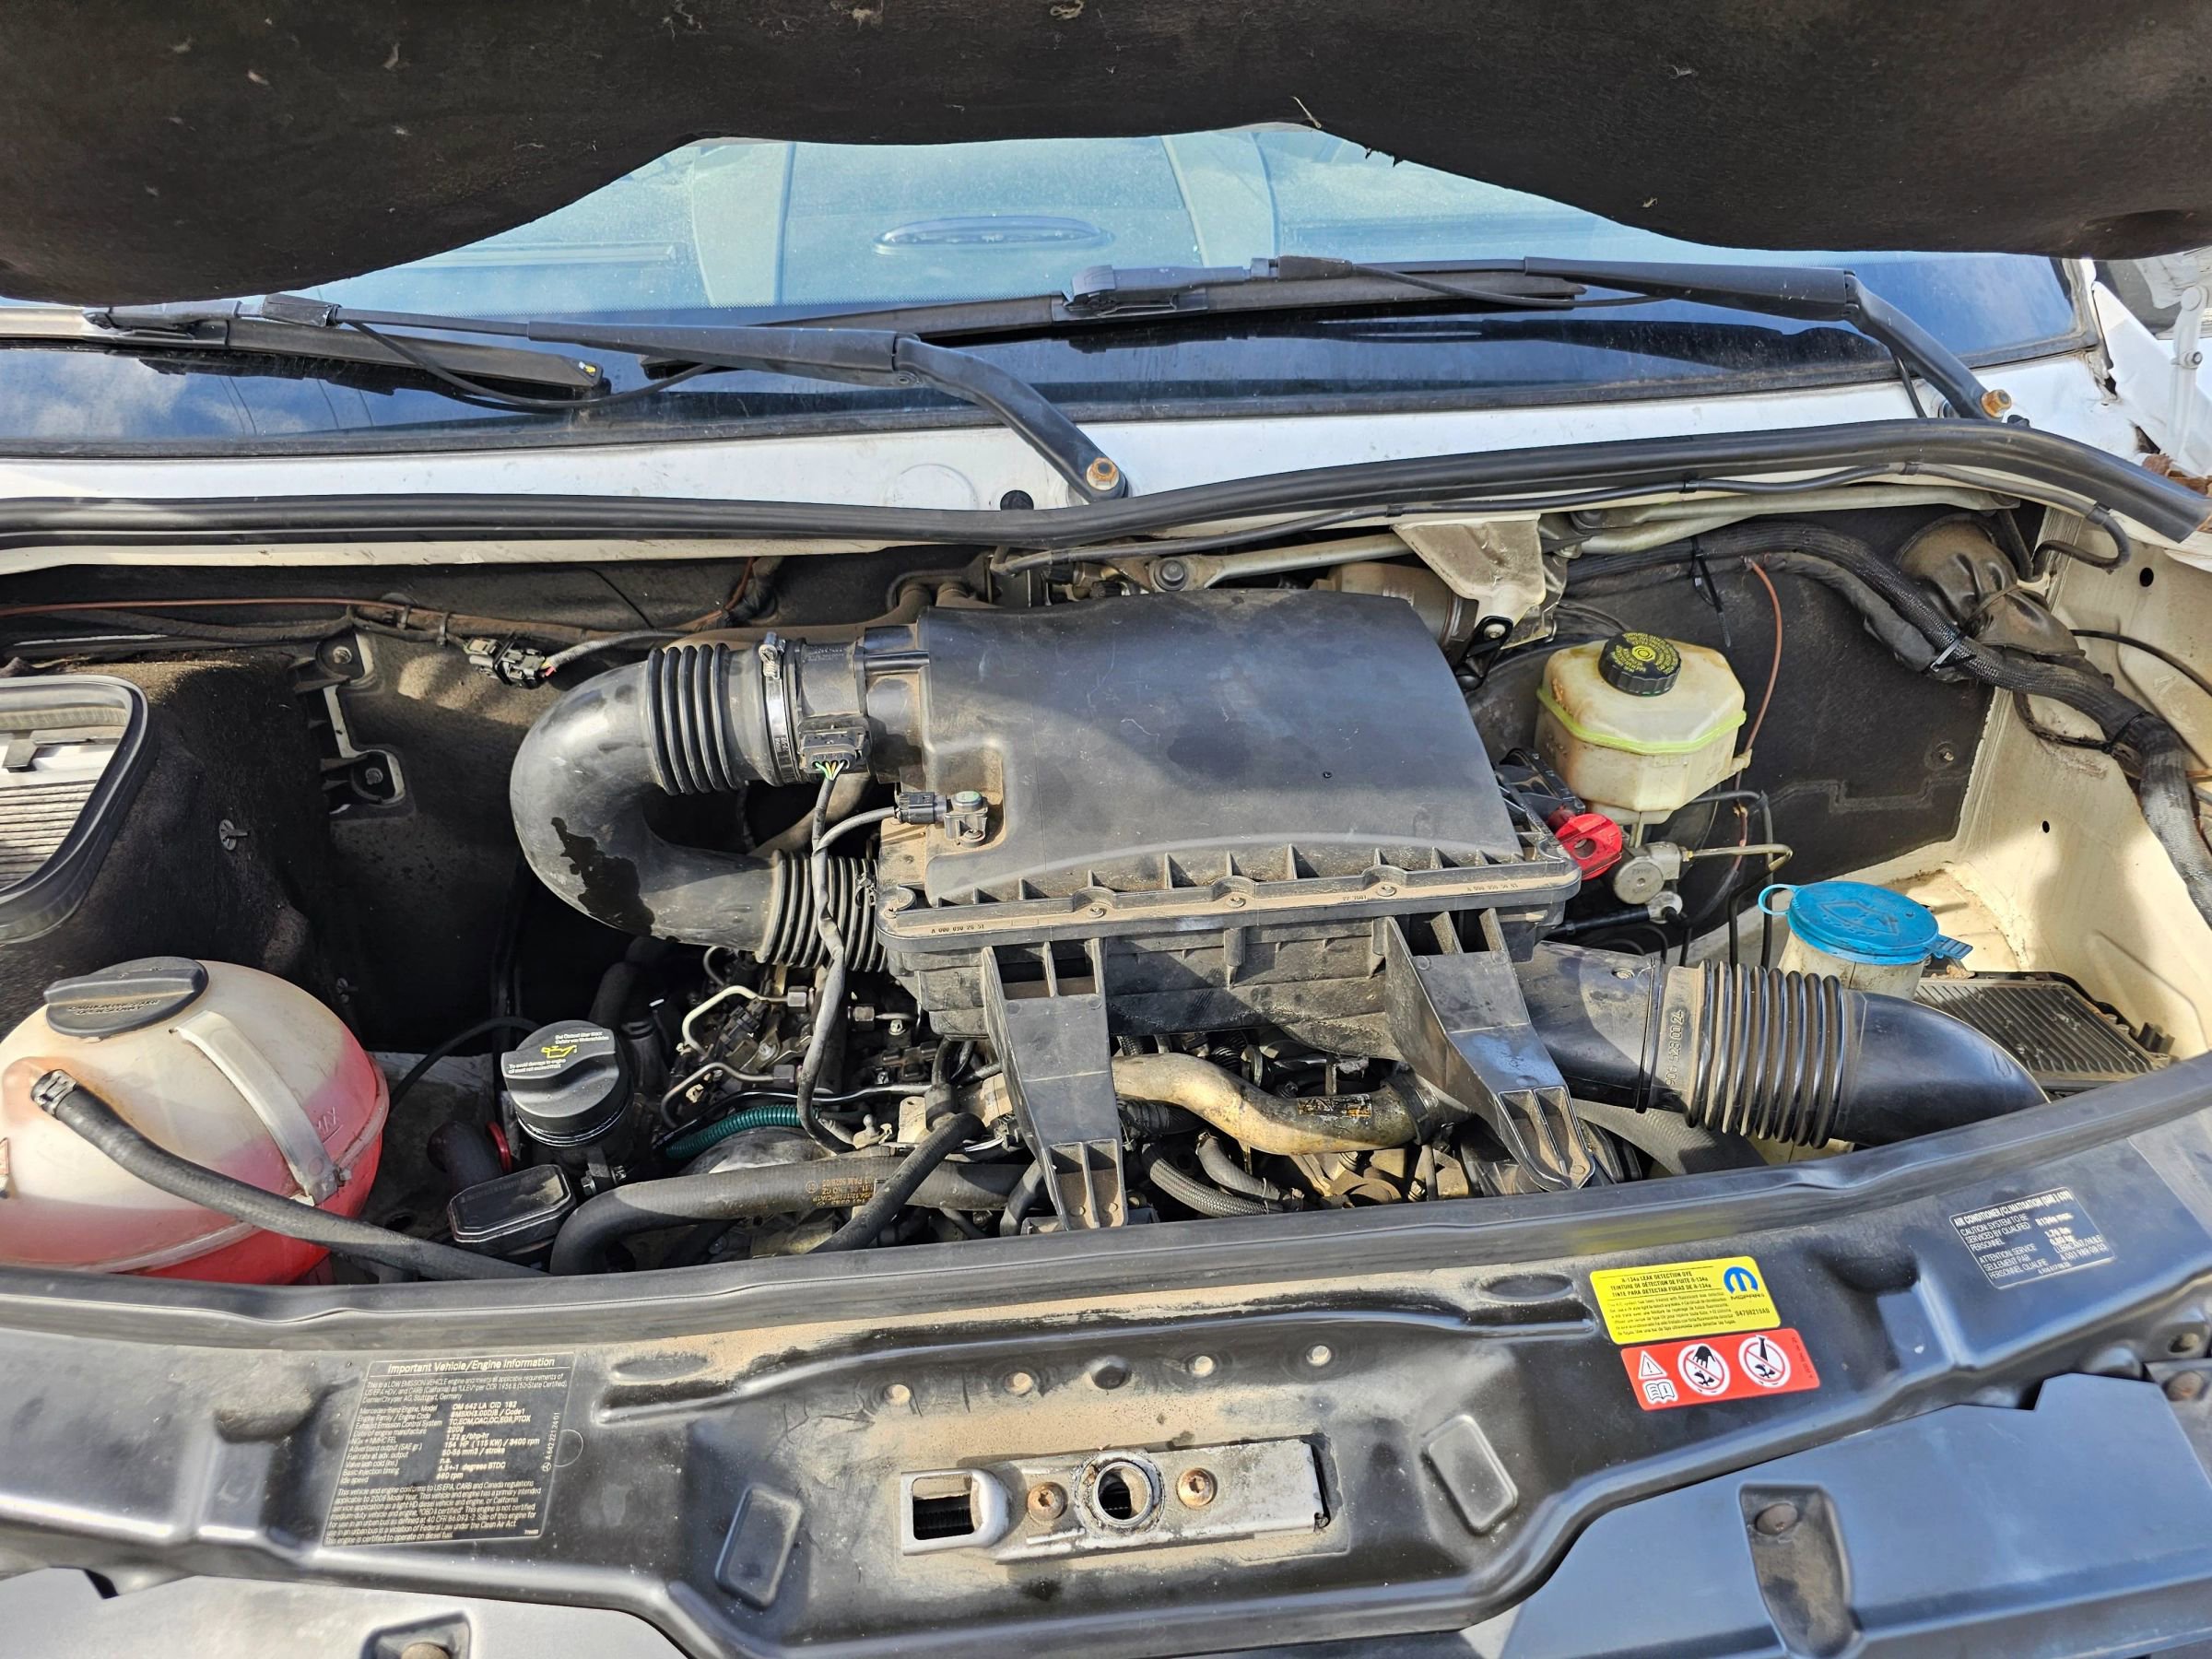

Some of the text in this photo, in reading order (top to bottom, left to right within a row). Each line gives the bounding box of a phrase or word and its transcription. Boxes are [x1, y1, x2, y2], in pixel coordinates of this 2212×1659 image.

[1953, 1218, 1966, 1227] AIR
[1987, 1218, 2012, 1229] SYSTEM
[1965, 1232, 1994, 1244] SERVICED
[2001, 1222, 2031, 1234] QUALIFIED
[1970, 1238, 2004, 1251] PERSONNEL
[2011, 1244, 2037, 1255] SERVICE
[2017, 1254, 2030, 1262] PAR
[1989, 1265, 2023, 1279] PERSONNEL
[387, 1358, 555, 1374] Important Vehicle/Engine Information
